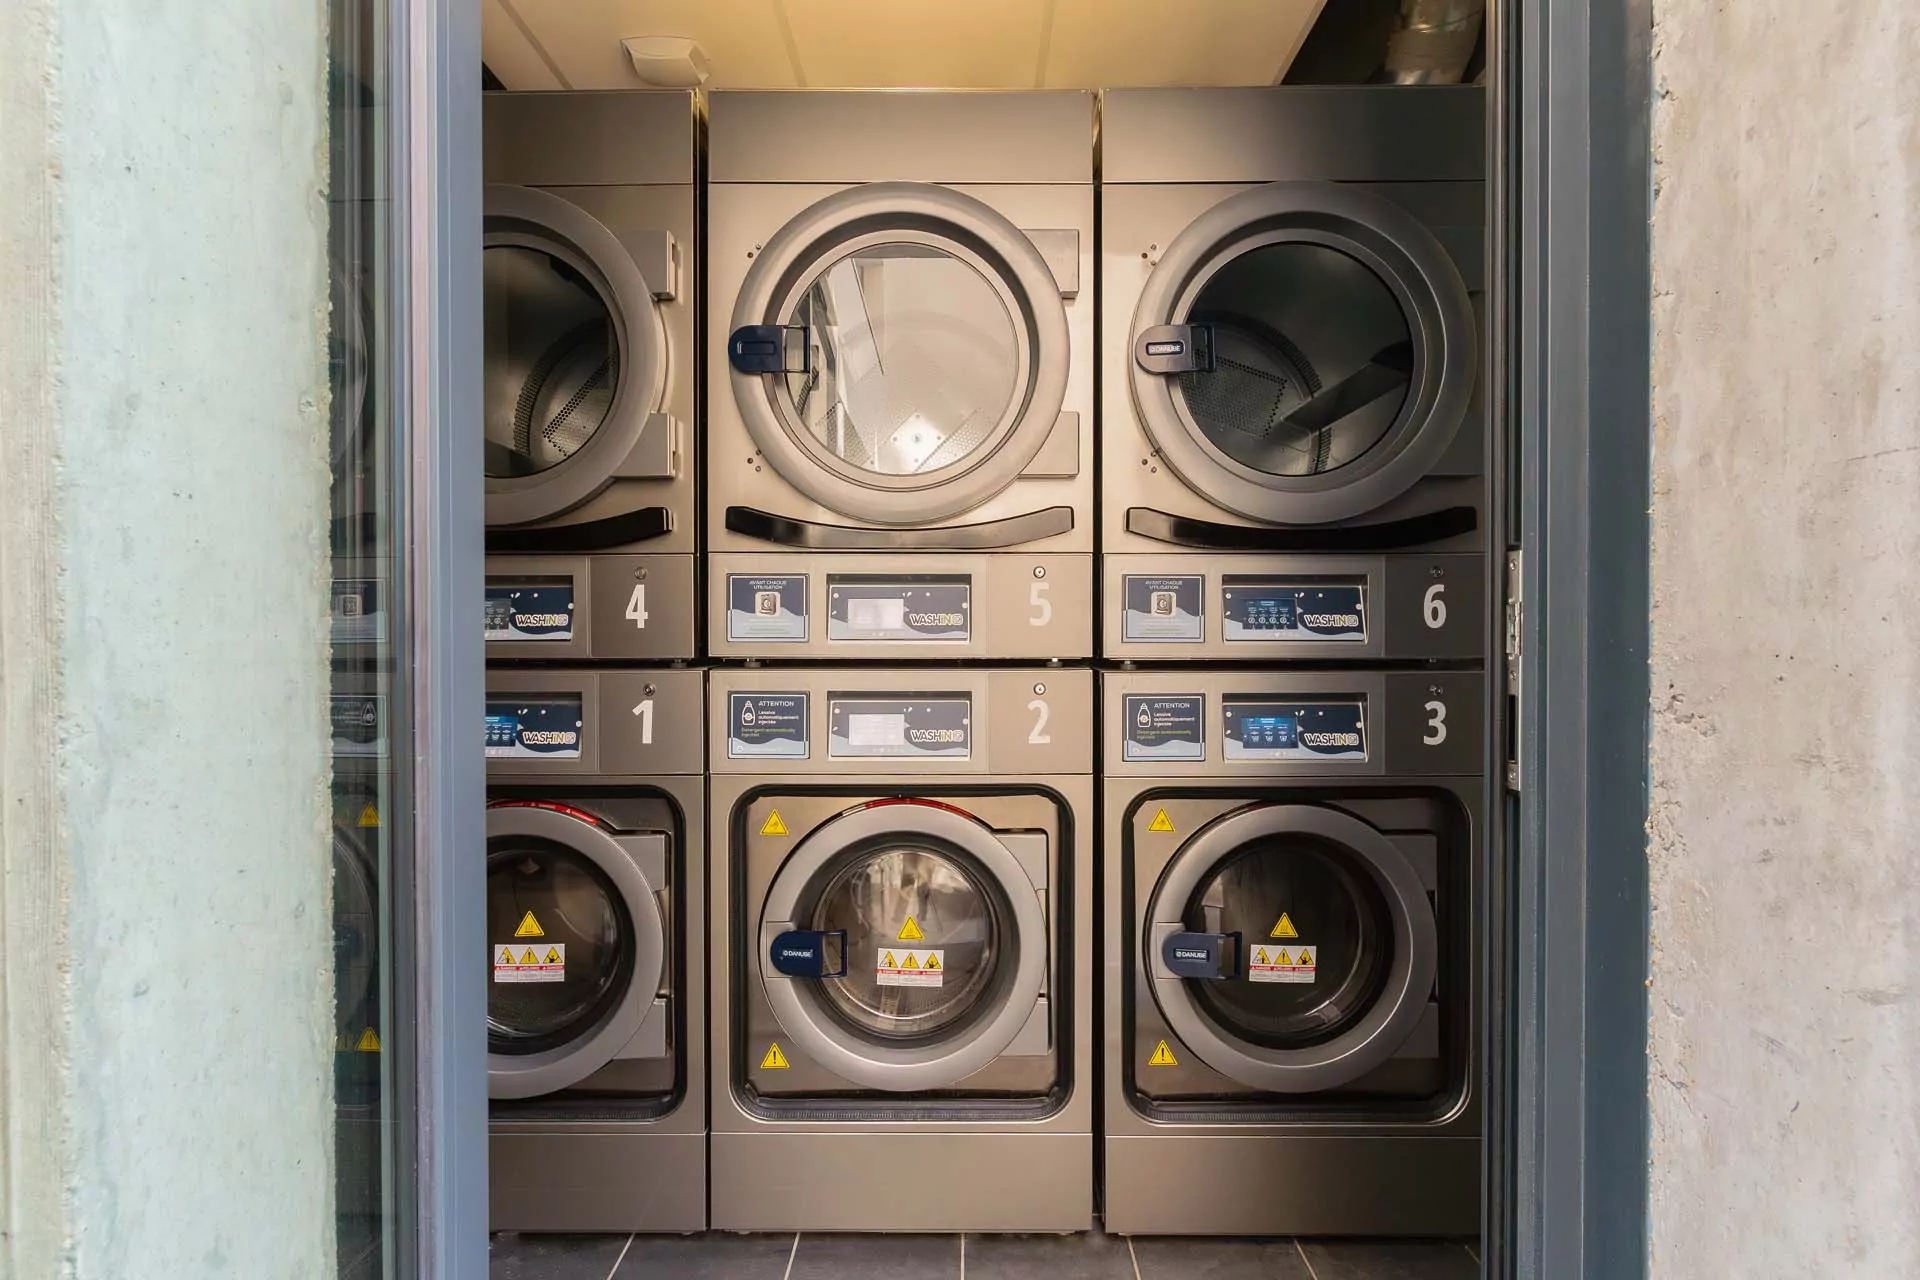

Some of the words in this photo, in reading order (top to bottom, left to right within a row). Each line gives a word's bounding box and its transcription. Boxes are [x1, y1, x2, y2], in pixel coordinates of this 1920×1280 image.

[625, 584, 649, 629] 4
[1029, 581, 1052, 626] 5
[1423, 584, 1447, 629] 6
[632, 699, 654, 745] 1
[1027, 699, 1051, 744] 2
[1423, 700, 1447, 746] 3
[788, 950, 813, 958] DANUBE
[1181, 951, 1207, 959] DANUBE
